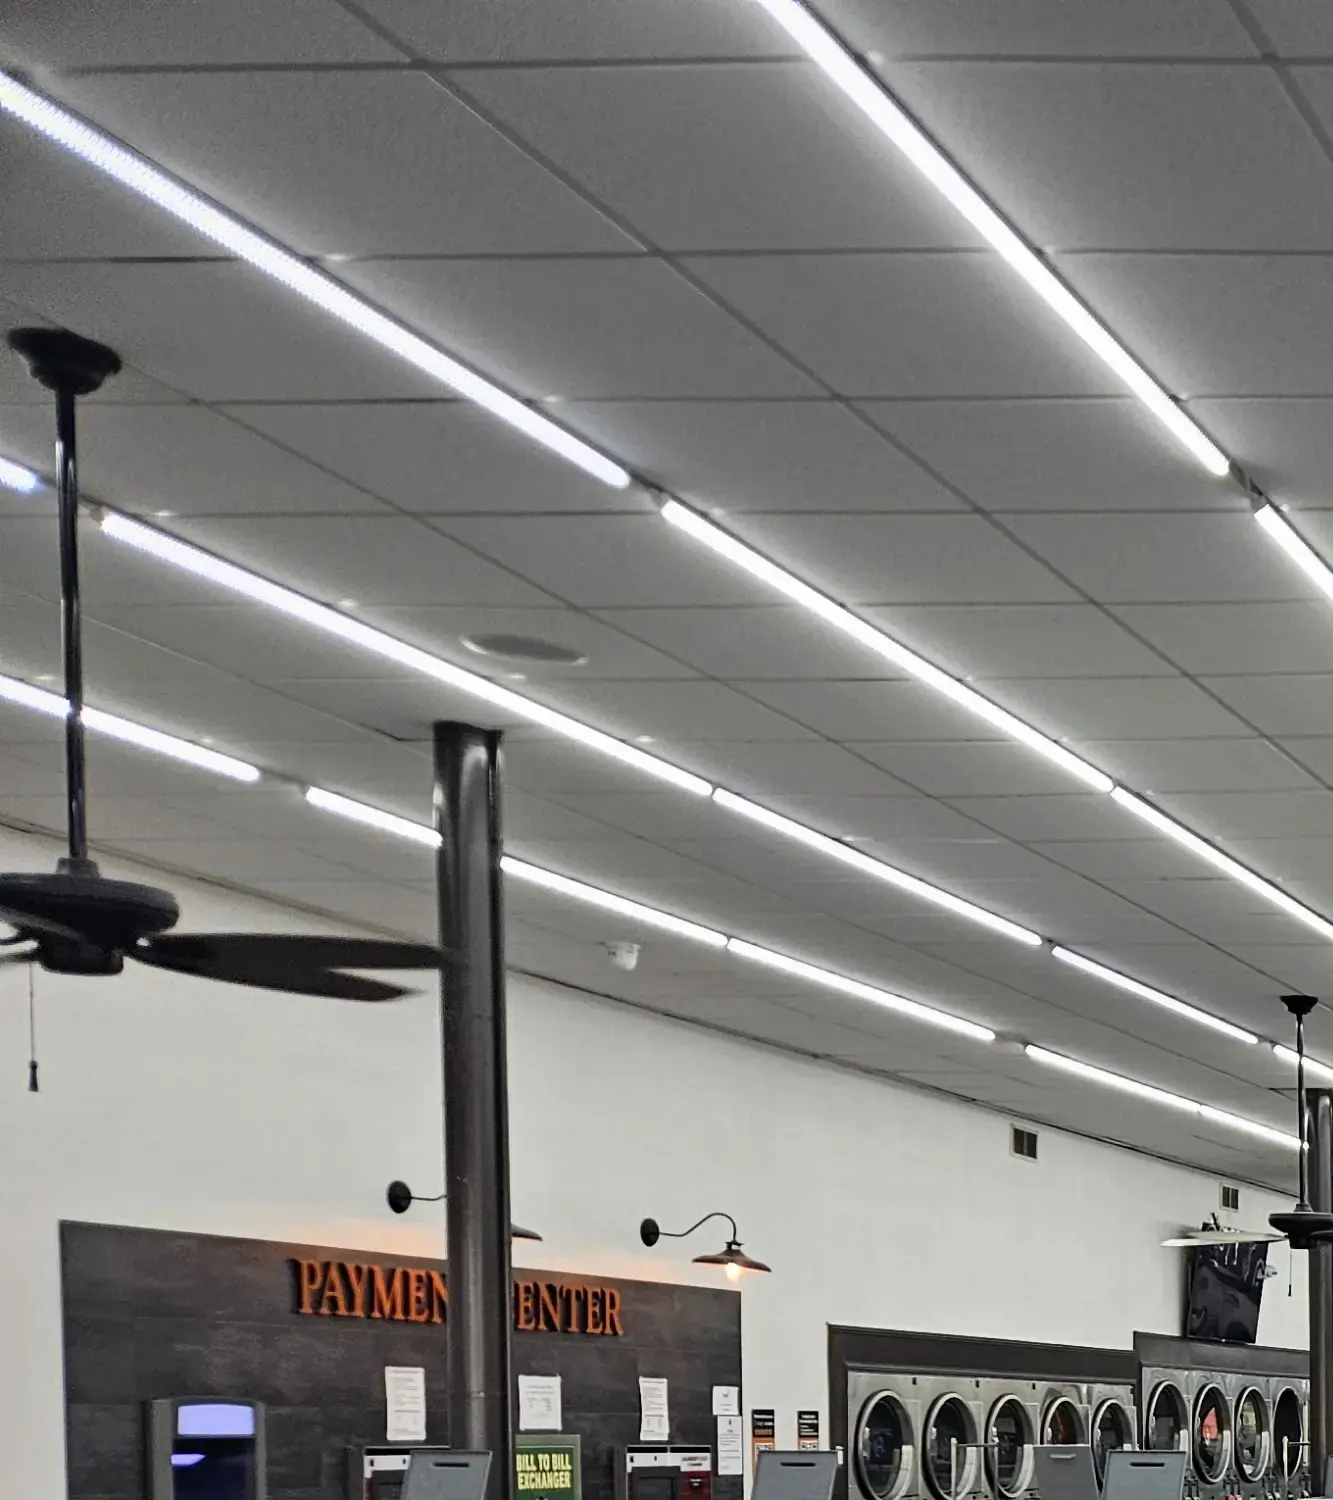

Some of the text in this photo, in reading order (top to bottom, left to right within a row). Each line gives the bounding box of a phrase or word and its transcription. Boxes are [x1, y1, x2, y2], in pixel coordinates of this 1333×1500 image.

[299, 1258, 624, 1337] PAYMEN ENTER
[516, 1453, 572, 1472] BILL TO BILL
[518, 1471, 571, 1490] EXCHANGER
